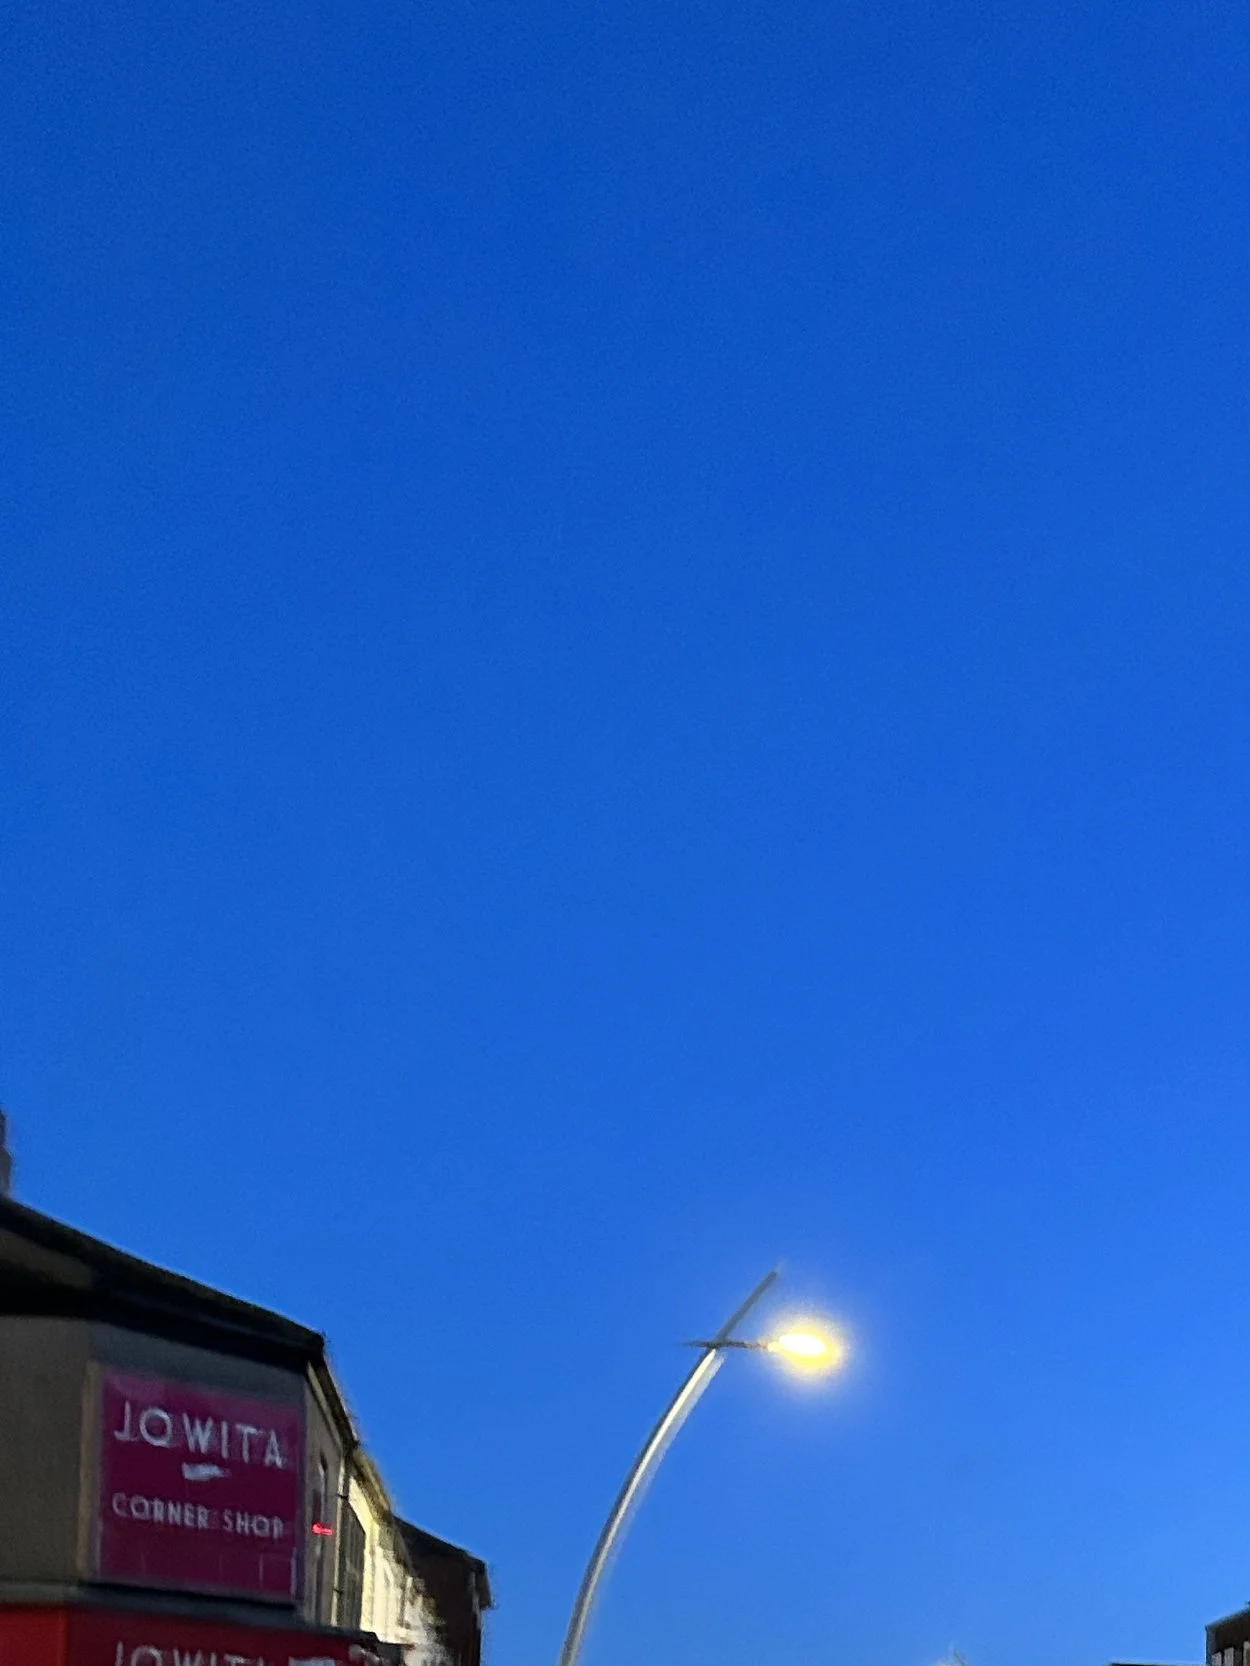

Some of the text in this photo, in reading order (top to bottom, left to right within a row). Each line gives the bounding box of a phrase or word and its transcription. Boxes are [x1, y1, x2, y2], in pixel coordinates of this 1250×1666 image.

[113, 1400, 286, 1469] JOWITA
[112, 1492, 285, 1540] CORNER SHOP
